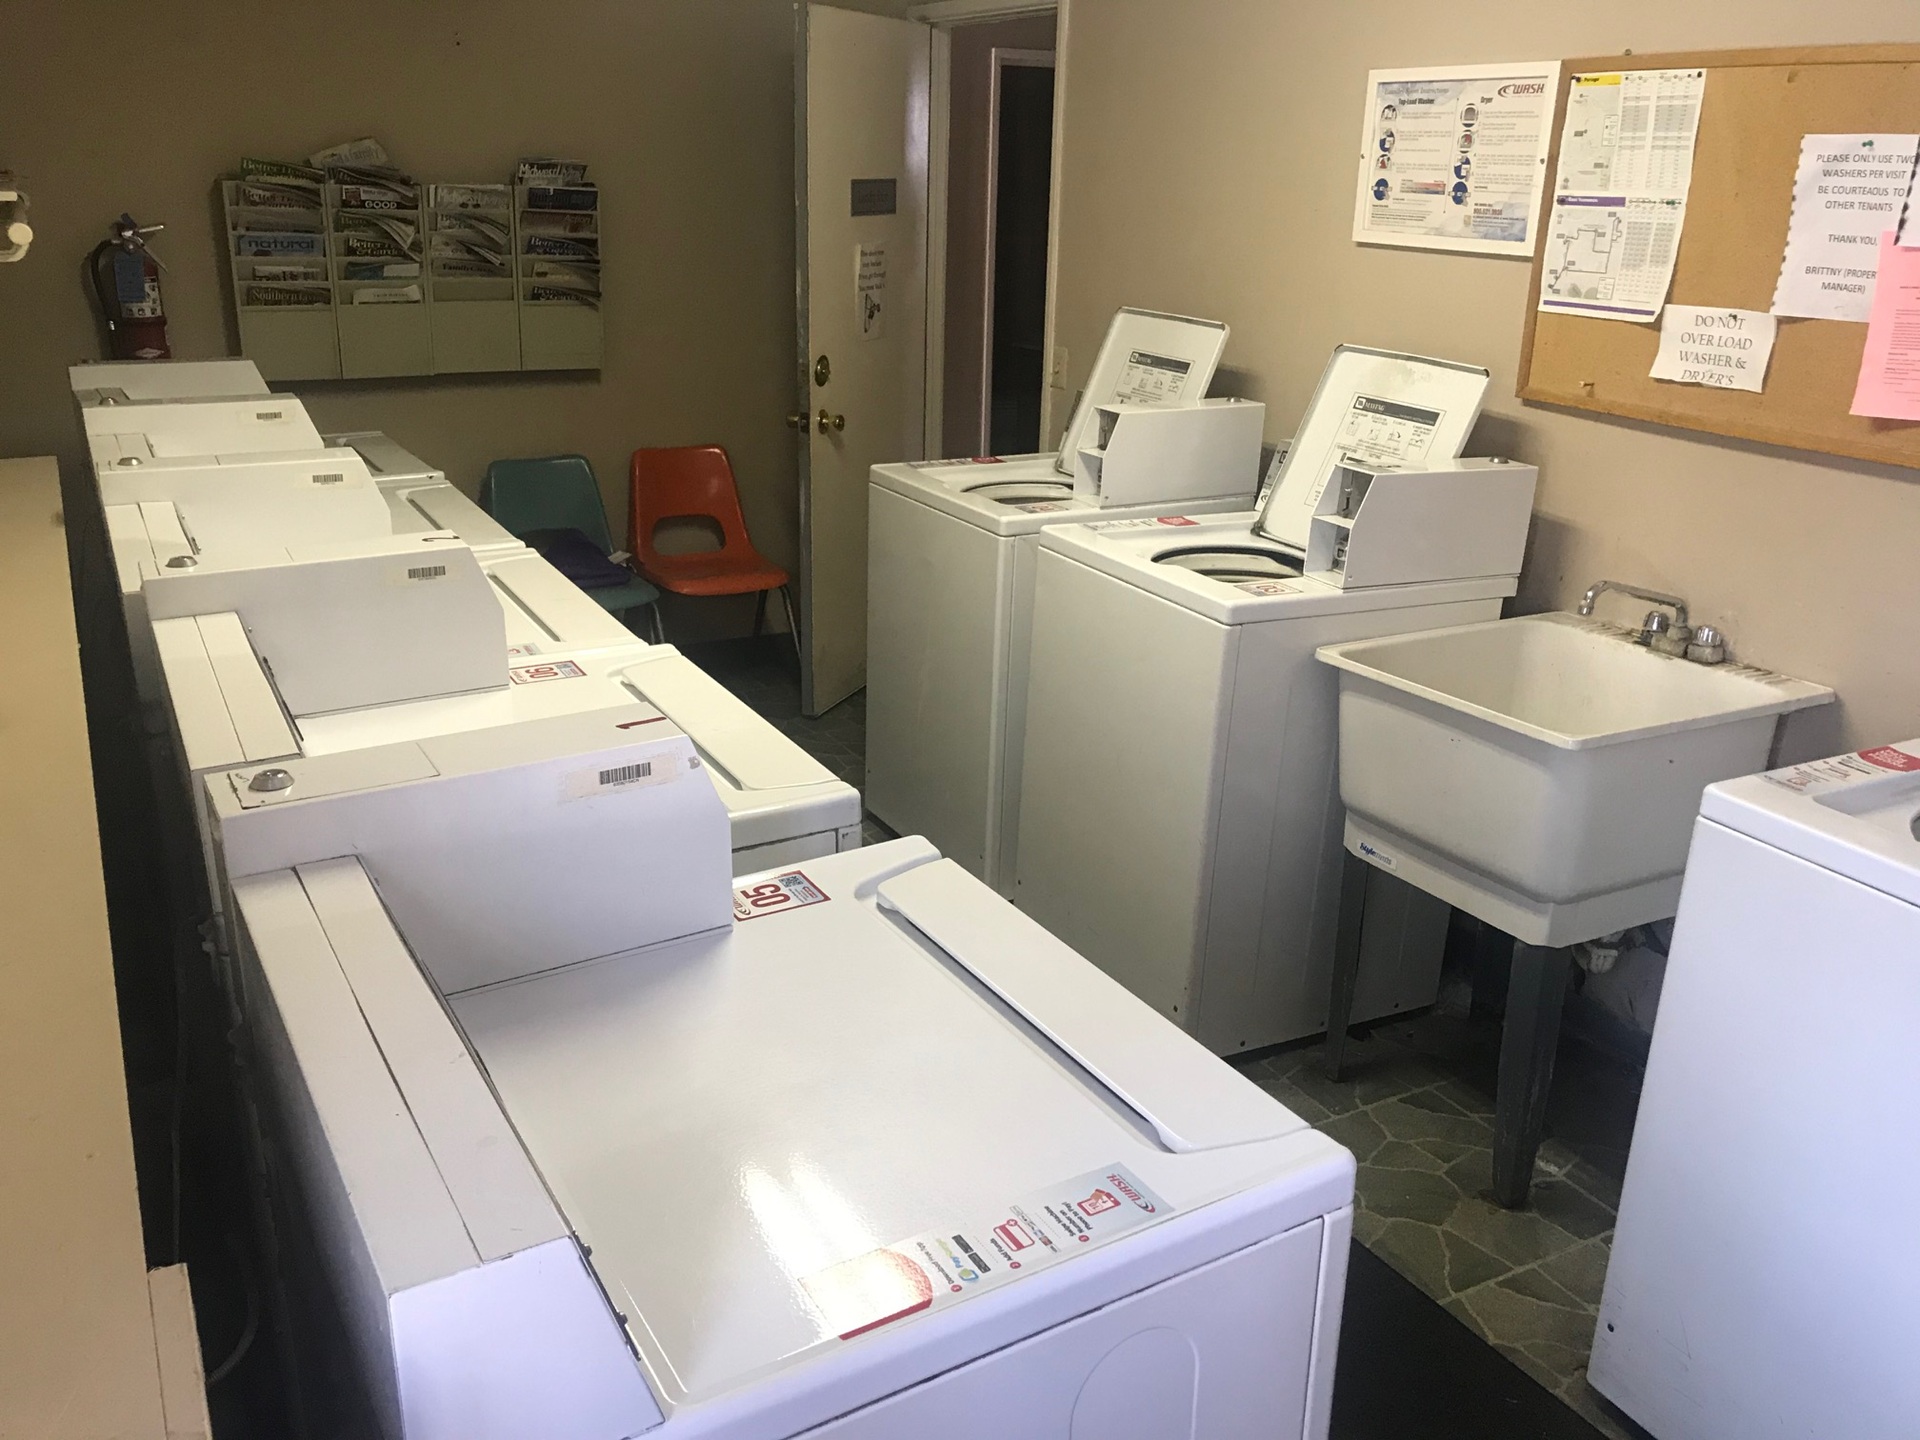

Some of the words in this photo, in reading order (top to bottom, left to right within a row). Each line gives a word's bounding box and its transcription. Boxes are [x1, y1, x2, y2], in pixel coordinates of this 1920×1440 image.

[1511, 83, 1545, 96] WASH
[1816, 153, 1850, 163] PLEASE
[1852, 154, 1876, 164] ONLY
[1877, 154, 1893, 164] USE
[1822, 169, 1868, 178] WASHERS
[1868, 170, 1884, 179] PER
[1885, 171, 1908, 180] VISIT
[1817, 186, 1830, 195] BE
[1893, 188, 1906, 197] TO
[365, 200, 398, 209] GOOD
[1824, 200, 1856, 210] OTHER
[1857, 201, 1894, 212] TENANTS
[247, 239, 315, 250] natural
[1828, 233, 1858, 244] THANK
[1804, 266, 1842, 277] BRITTNY
[1843, 268, 1878, 280] (PROPER
[252, 287, 300, 301] Southern
[1821, 282, 1866, 295] MANAGER)
[1695, 314, 1715, 328] DO
[1717, 315, 1747, 331] NOT
[1680, 331, 1715, 347] OVER
[1716, 335, 1753, 351] LOAD
[1679, 350, 1733, 369] WASHER
[1735, 357, 1747, 370] &
[1680, 369, 1735, 386] DRYER'S
[525, 666, 559, 679] 06
[615, 716, 667, 730] 1
[740, 883, 791, 908] 05
[1106, 1173, 1142, 1202] WASH
[1043, 1205, 1063, 1224] Machine
[1066, 1216, 1085, 1234] Number
